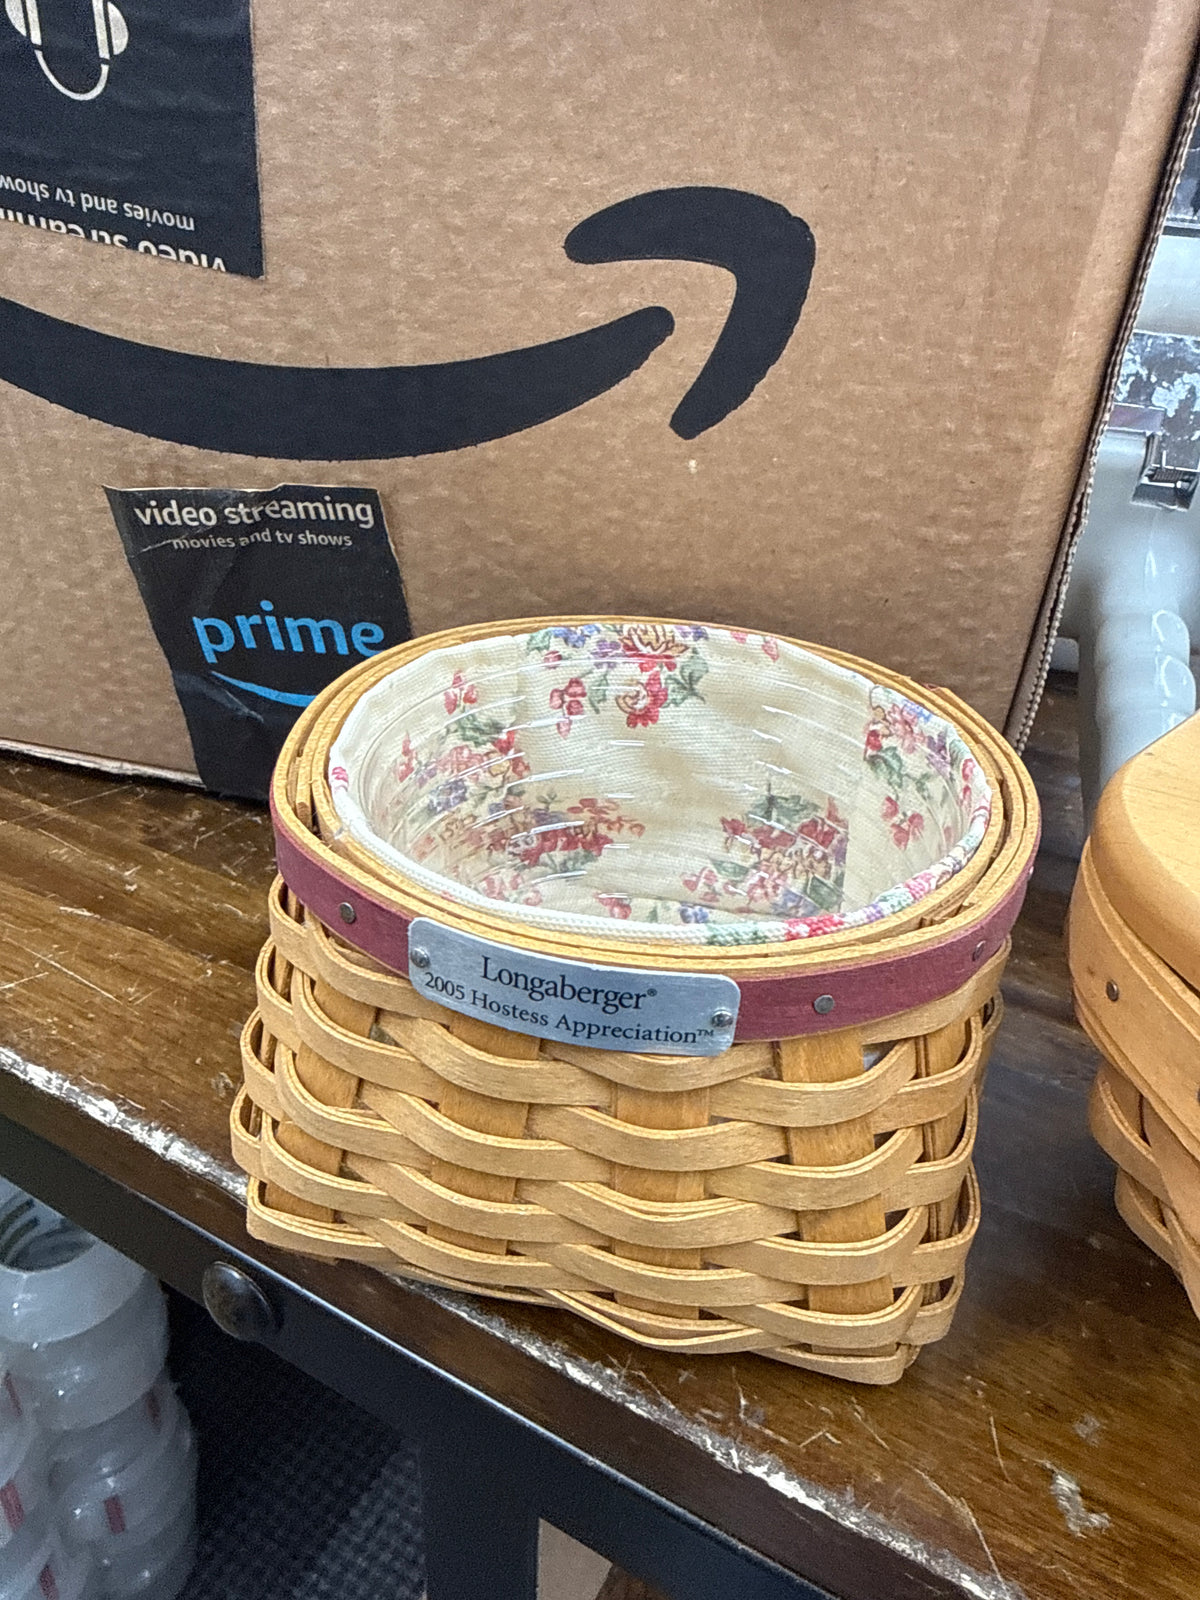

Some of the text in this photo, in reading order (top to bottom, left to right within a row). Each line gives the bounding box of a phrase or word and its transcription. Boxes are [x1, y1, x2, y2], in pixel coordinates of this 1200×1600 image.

[55, 187, 76, 207] tv
[80, 192, 119, 214] and
[123, 202, 195, 231] movies
[134, 495, 375, 529] video streaming
[172, 528, 353, 551] movies and tv shows
[192, 599, 385, 665] prime
[423, 971, 715, 1045] 2005 Hostess Appreciation™
